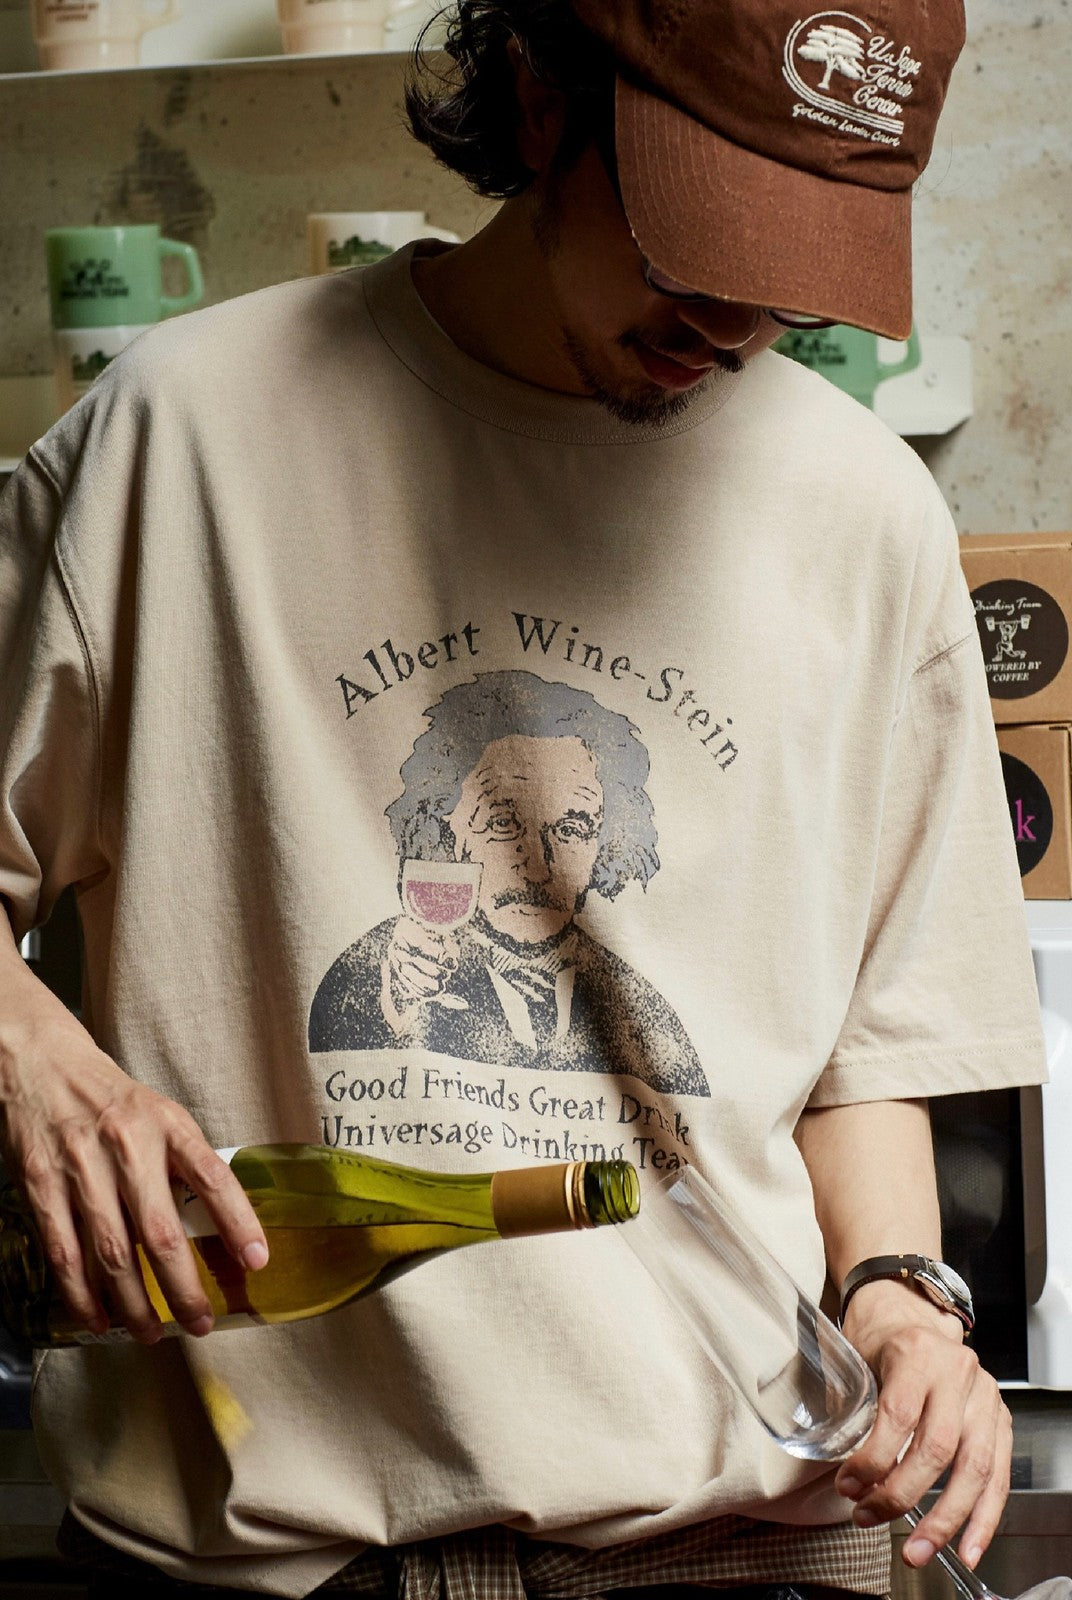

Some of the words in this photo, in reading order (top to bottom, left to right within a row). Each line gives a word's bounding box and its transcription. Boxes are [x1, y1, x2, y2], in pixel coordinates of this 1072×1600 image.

[853, 84, 903, 116] Center
[792, 103, 839, 127] Golden
[974, 598, 1015, 616] Drinking
[1016, 597, 1042, 609] Team
[985, 662, 1026, 672] OWERED
[1028, 661, 1042, 670] BY
[992, 672, 1030, 683] COFFEE
[335, 621, 480, 719] Albert
[511, 612, 739, 770] Wine-Stein
[325, 1066, 408, 1102] Good
[421, 1068, 520, 1112] Friends
[529, 1086, 606, 1121] Great
[321, 1115, 493, 1154] Universage
[632, 1136, 690, 1170] Tea
